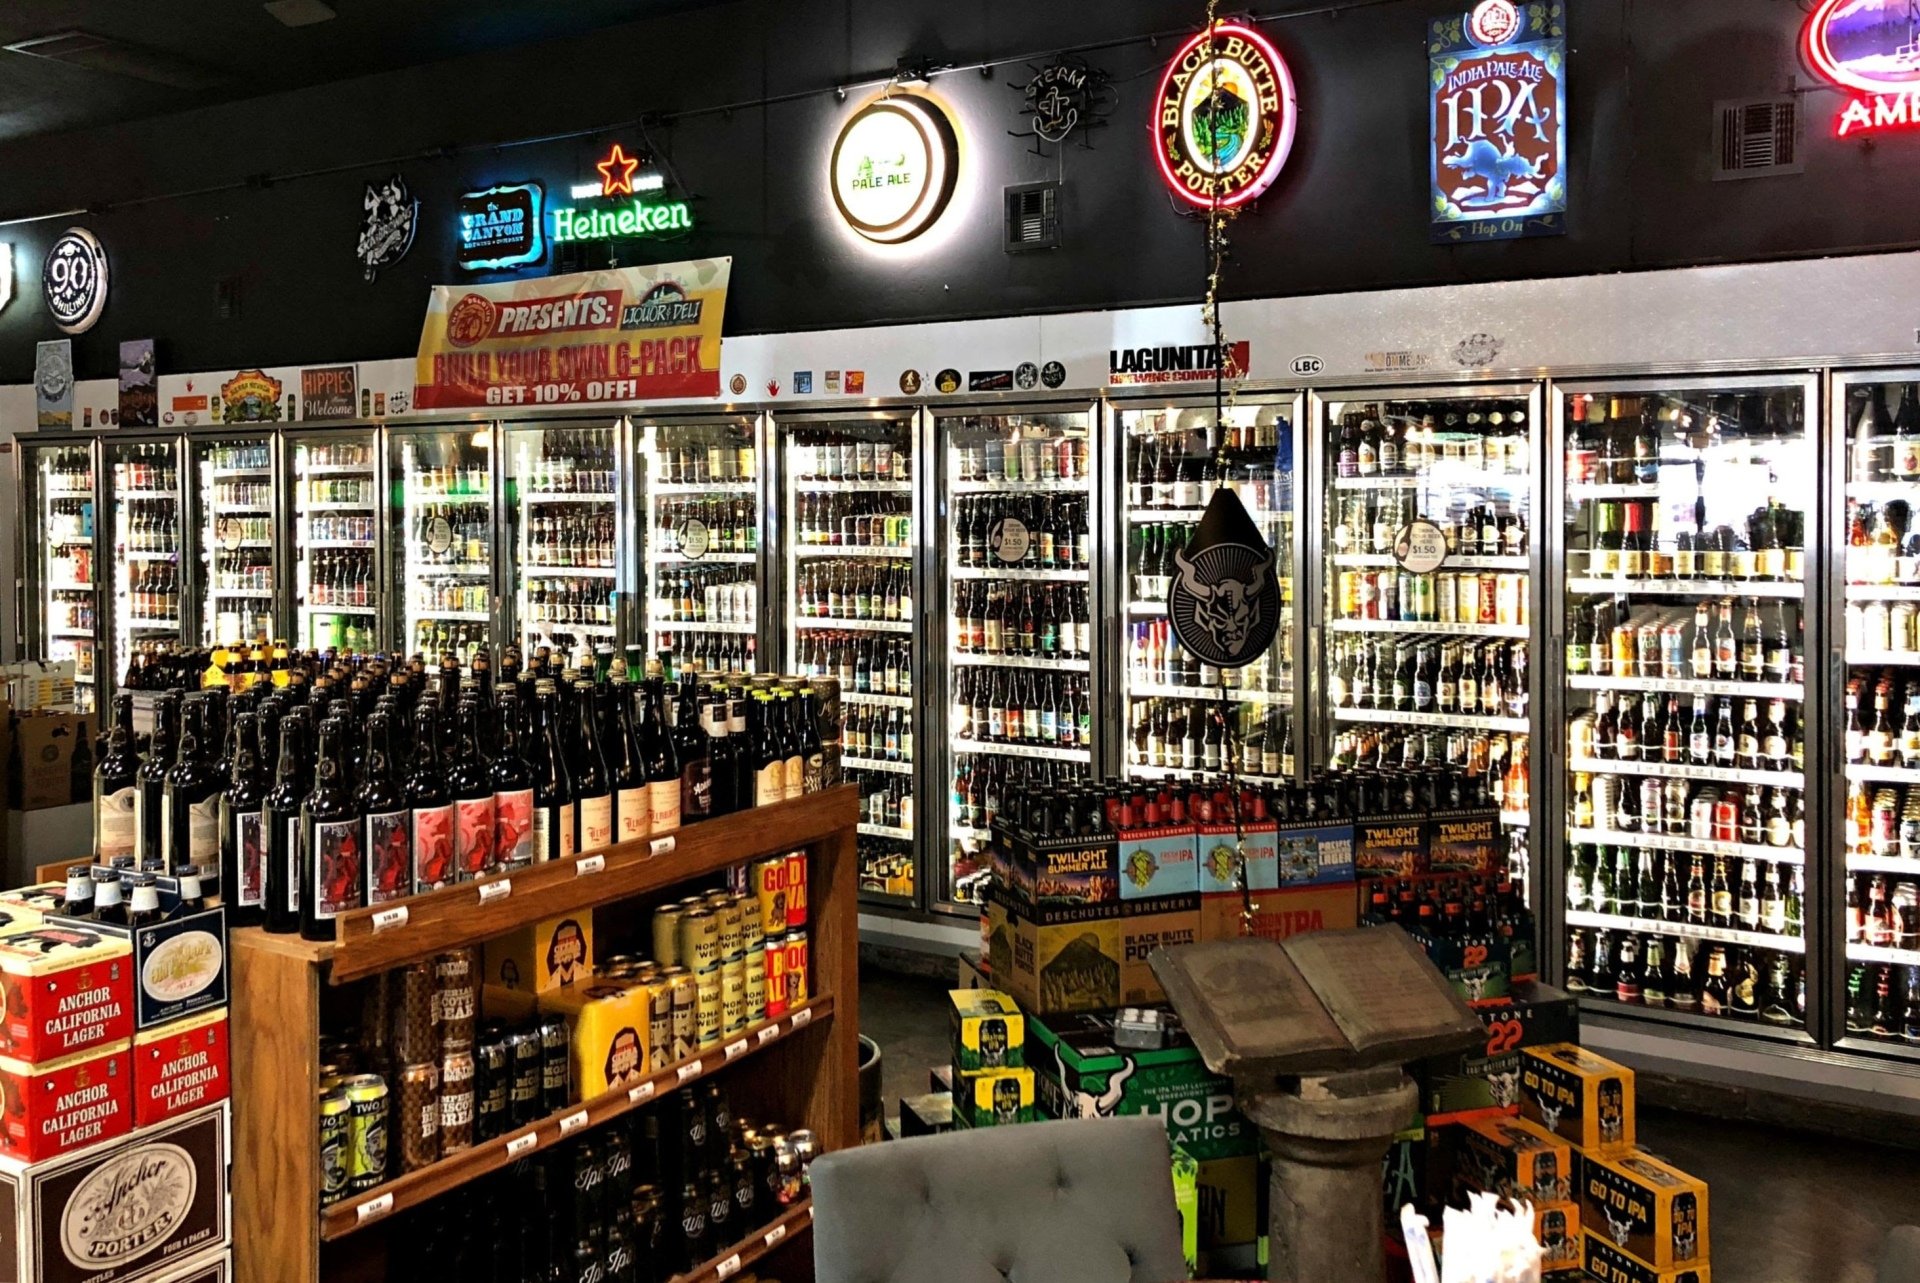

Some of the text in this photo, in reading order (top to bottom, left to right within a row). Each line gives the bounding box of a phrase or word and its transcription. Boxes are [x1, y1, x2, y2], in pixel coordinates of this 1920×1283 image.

[1025, 66, 1086, 97] STEAM
[1162, 36, 1279, 128] BLACK BUTTE
[1448, 60, 1543, 93] INDIA PALE ALE
[1441, 79, 1551, 152] IPA
[852, 172, 911, 190] PALE ALE
[1175, 151, 1267, 195] PORTER
[462, 208, 524, 229] GRAND
[554, 200, 692, 242] Heineken
[1471, 217, 1524, 236] Hop On
[462, 222, 524, 242] CANYON
[52, 256, 88, 294] 90
[498, 296, 614, 333] PRESENTS:
[622, 304, 666, 326] LIQUOR
[673, 301, 700, 319] DELI
[616, 334, 703, 378] 6-PACK
[1295, 360, 1320, 372] LBC
[302, 370, 353, 395] HIPPIES
[486, 379, 637, 405] GET 10% OFF!
[304, 400, 354, 417] Welcome
[1039, 834, 1115, 847] DESCHUTES BREWERY
[1365, 827, 1420, 841] TWILIGHT
[1439, 831, 1493, 844] SUMMER ALE
[1440, 822, 1494, 836] TWILIGHT
[1261, 847, 1275, 859] IPA
[1365, 837, 1419, 849] SUMMER ALE
[1047, 848, 1108, 865] TWILIGHT
[1047, 860, 1109, 875] SUMMER ALE
[1180, 849, 1194, 862] IPA
[1318, 851, 1352, 866] LAGER
[1045, 904, 1120, 923] DESCHUTES
[1134, 899, 1194, 914] BREWERY
[1125, 929, 1195, 946] BLACK BUTTE
[58, 986, 112, 1014] ANCHOR
[45, 1002, 121, 1035] CALIFORNIA
[63, 1024, 105, 1048] LAGER
[1487, 1019, 1524, 1057] 22
[160, 1051, 208, 1079] ANCHOR
[1533, 1061, 1567, 1080] STONE
[151, 1065, 219, 1100] CALIFORNIA
[1524, 1070, 1576, 1108] GO TO IPA
[56, 1083, 109, 1112] ANCHOR
[167, 1085, 205, 1111] LAGER
[355, 1101, 380, 1115] TWO
[42, 1099, 119, 1136] CALIFORNIA
[1140, 1094, 1234, 1128] HOP
[60, 1122, 102, 1147] LAGER
[1167, 1122, 1241, 1143] ATICS
[1601, 1169, 1637, 1193] STONE
[80, 1155, 167, 1236] Anchor
[1590, 1179, 1647, 1224] GO TO IPA
[89, 1211, 173, 1258] PORTER
[189, 1228, 211, 1244] PACKS
[1677, 1222, 1693, 1236] IPA
[1592, 1256, 1608, 1277] GO
